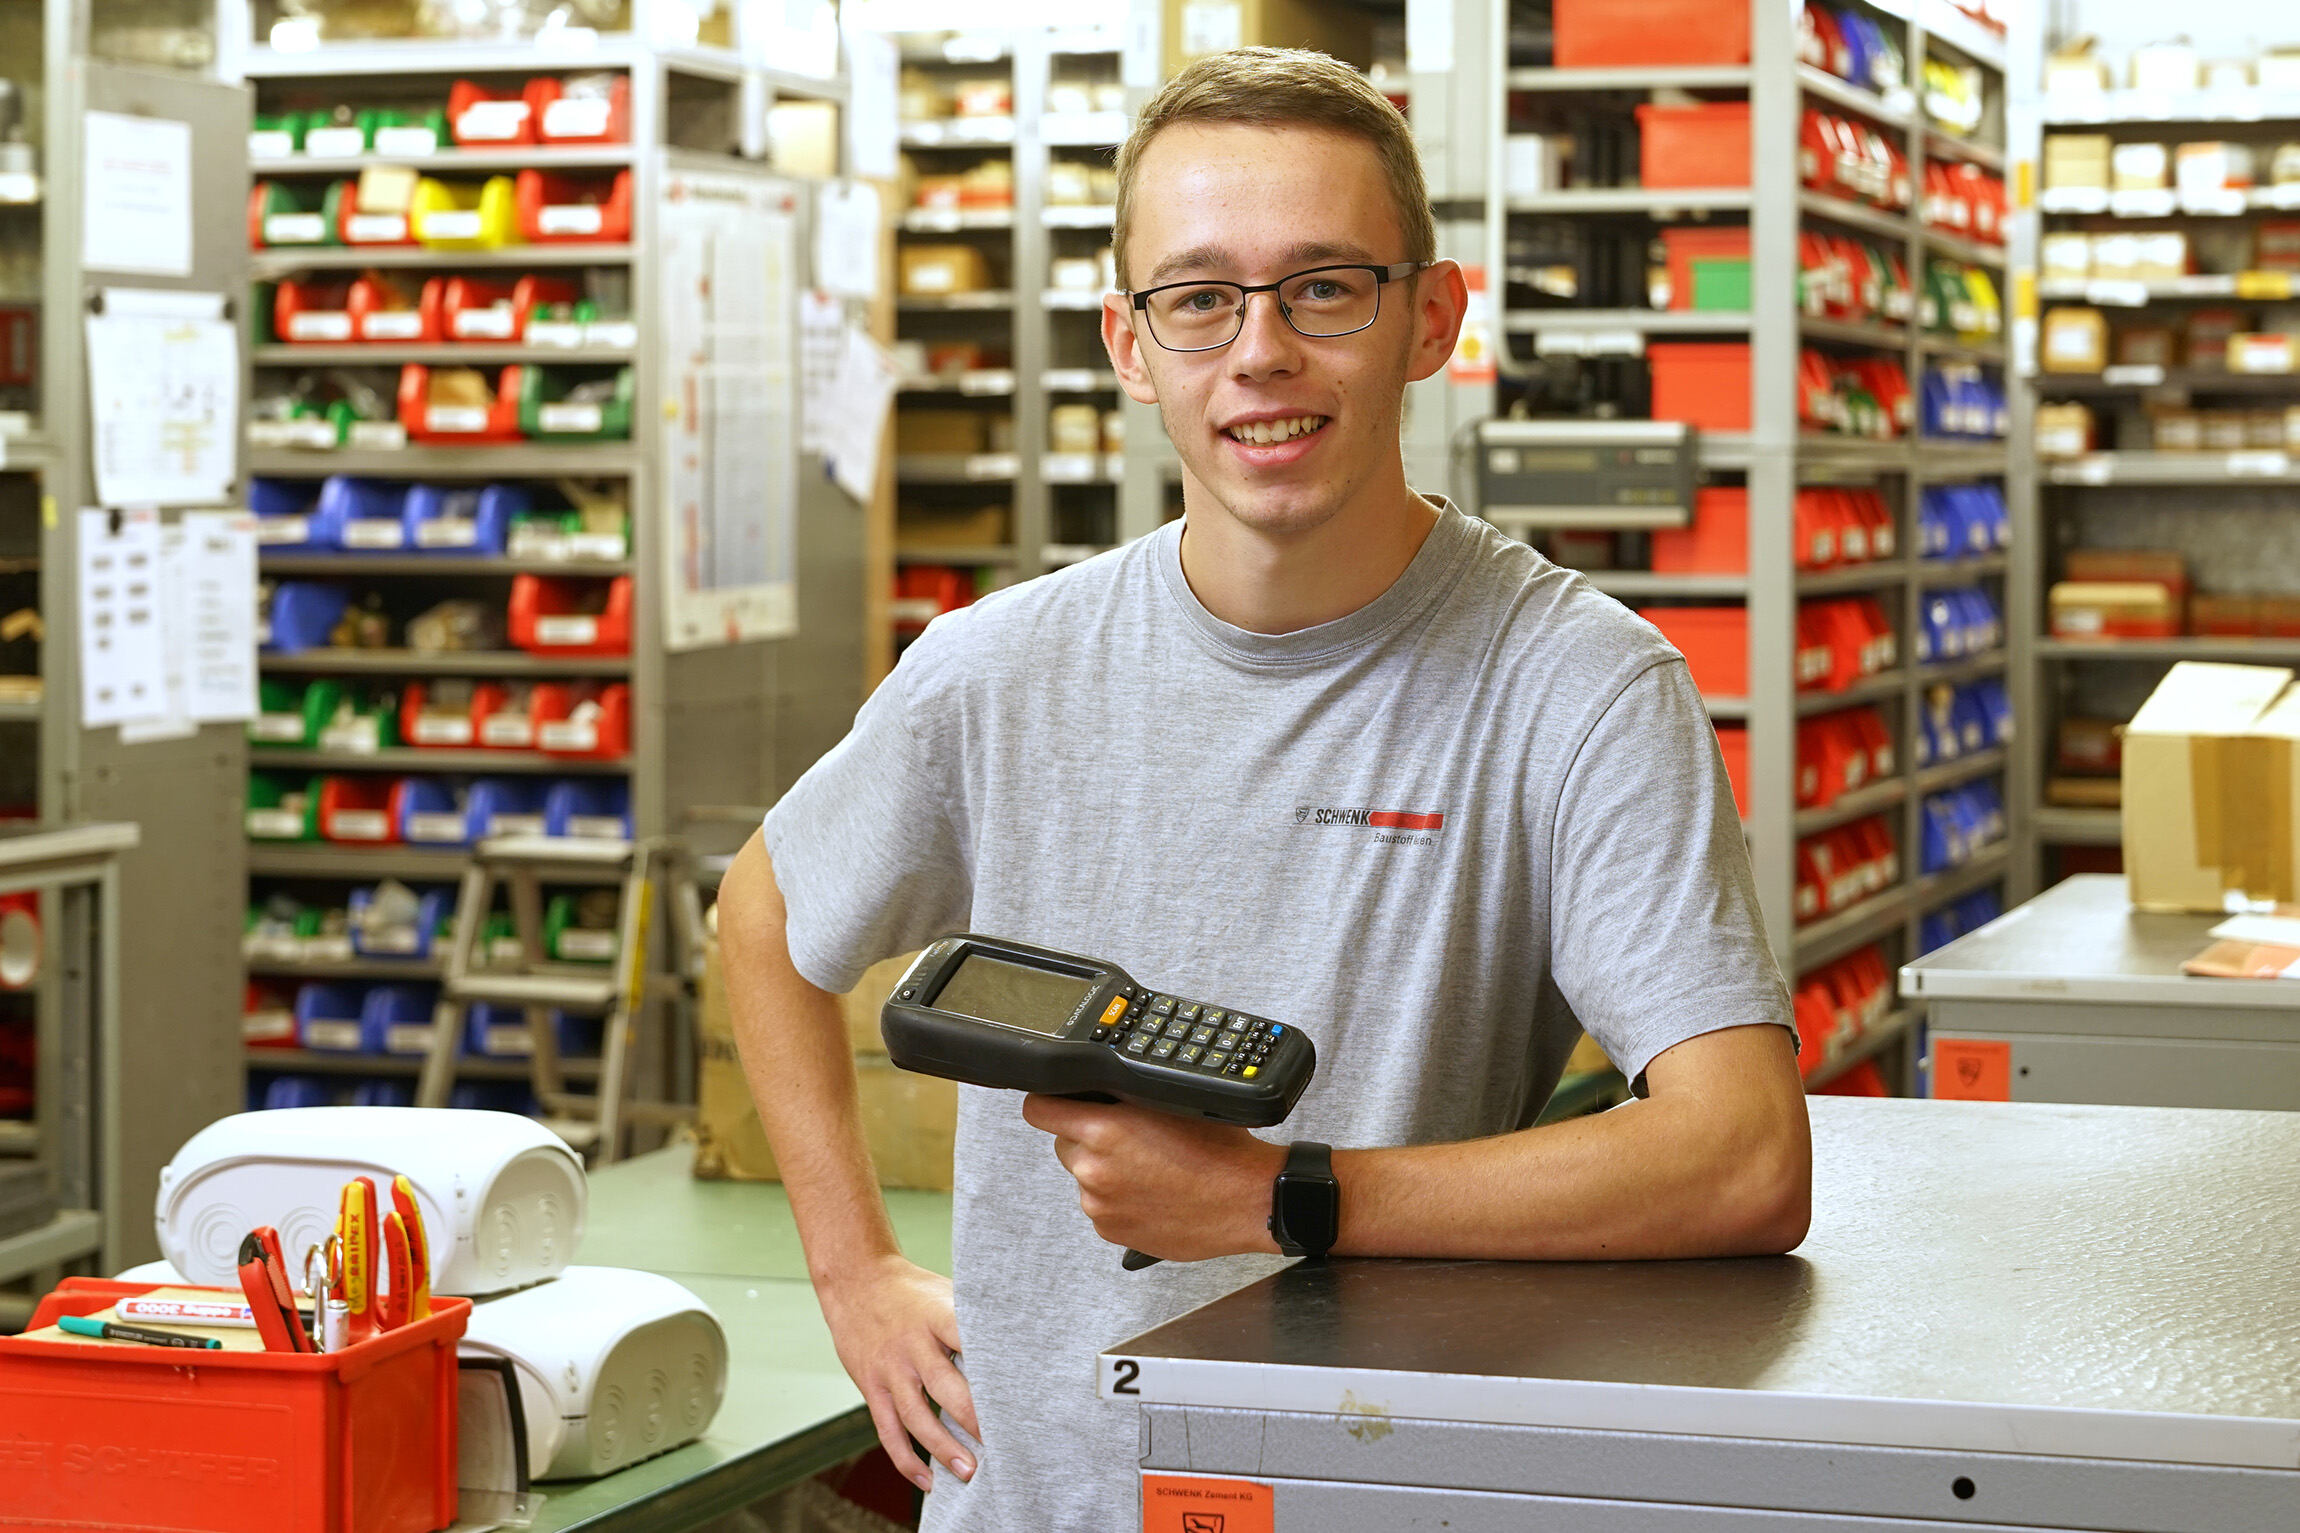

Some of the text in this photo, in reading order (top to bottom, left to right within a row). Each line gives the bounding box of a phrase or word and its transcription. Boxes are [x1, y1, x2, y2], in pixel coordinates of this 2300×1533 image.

[1315, 808, 1371, 826] SCHWENK
[1108, 1003, 1121, 1016] SCAN
[135, 1303, 181, 1315] 3000
[1113, 1360, 1140, 1394] 2
[1155, 1487, 1254, 1501] SCHWENK Zement KG
